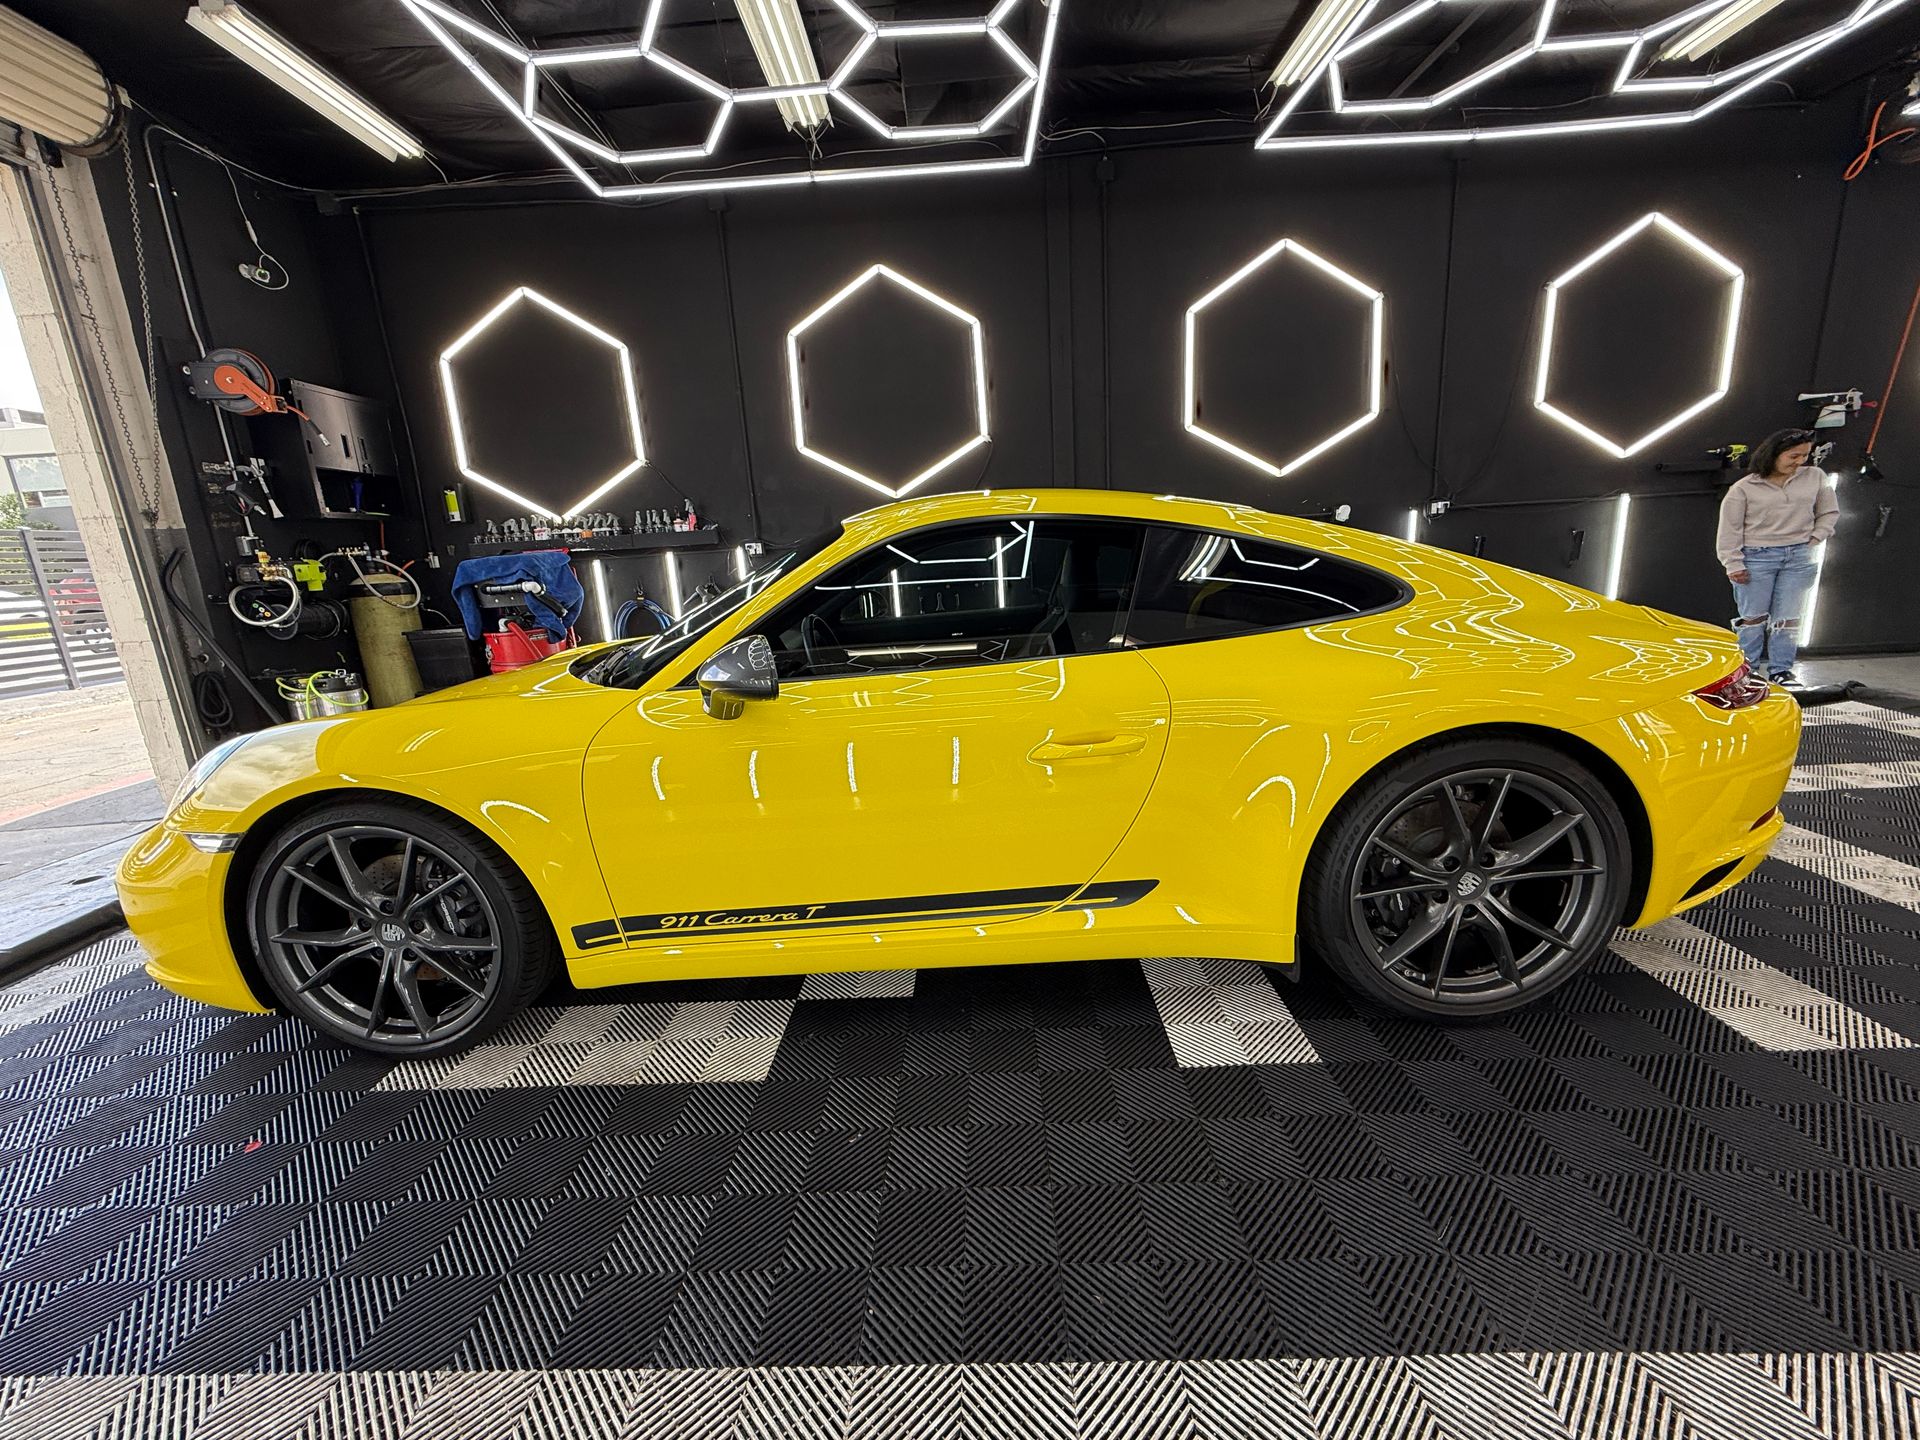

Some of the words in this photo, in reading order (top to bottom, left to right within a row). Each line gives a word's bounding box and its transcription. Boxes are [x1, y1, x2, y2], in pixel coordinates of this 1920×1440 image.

[661, 914, 700, 928] 911
[704, 912, 798, 925] Carrera
[805, 905, 827, 919] T
